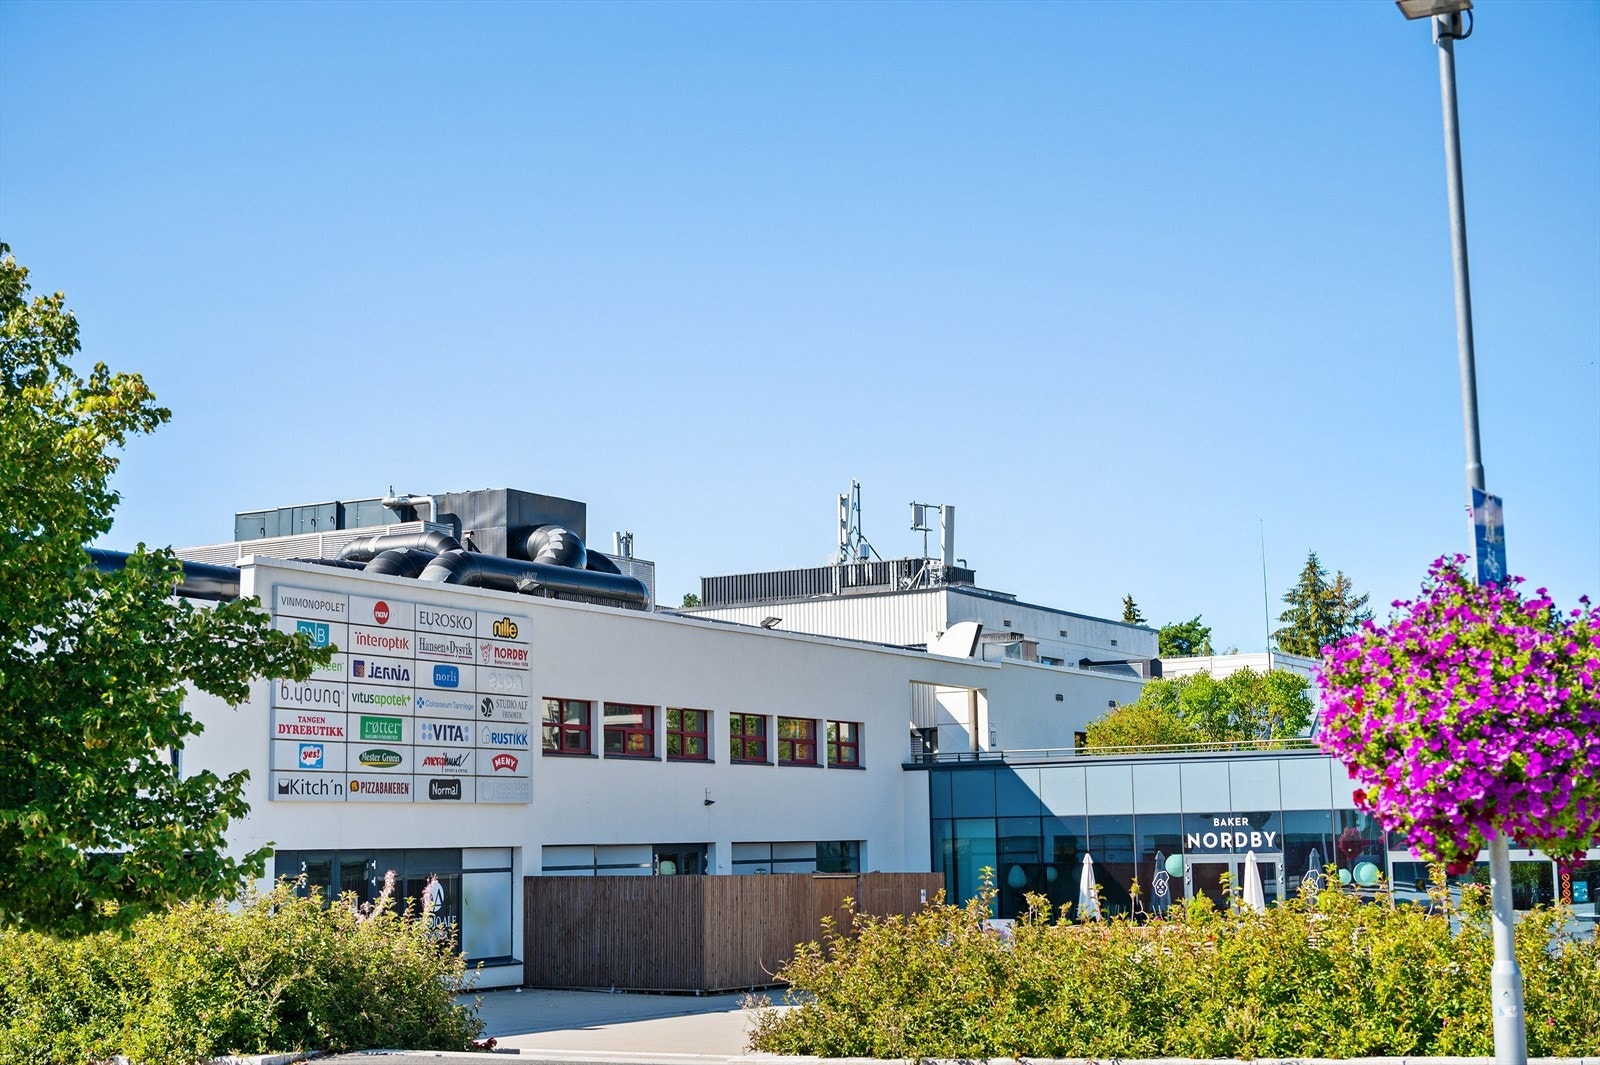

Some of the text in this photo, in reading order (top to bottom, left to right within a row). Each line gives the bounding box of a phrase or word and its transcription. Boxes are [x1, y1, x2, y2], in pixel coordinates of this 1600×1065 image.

[281, 596, 345, 612] VINMONOPOLET
[420, 611, 472, 630] EUROSKO
[493, 617, 518, 639] nille
[435, 671, 457, 681] norli
[425, 699, 452, 709] Colosseum
[496, 699, 517, 709] STUDIO
[298, 715, 326, 724] TANGEN
[278, 723, 344, 737] DYREBUTIKK
[363, 721, 402, 735] røtter
[433, 724, 464, 742] VITA
[491, 732, 528, 746] RUSTIKK
[303, 749, 320, 760] yes!
[361, 752, 380, 762] Mester
[494, 757, 516, 767] MENY
[360, 781, 409, 794] PIZZABAKEREN
[432, 782, 459, 796] Normal
[1213, 817, 1249, 827] BAKER
[1187, 831, 1276, 849] NORDBY
